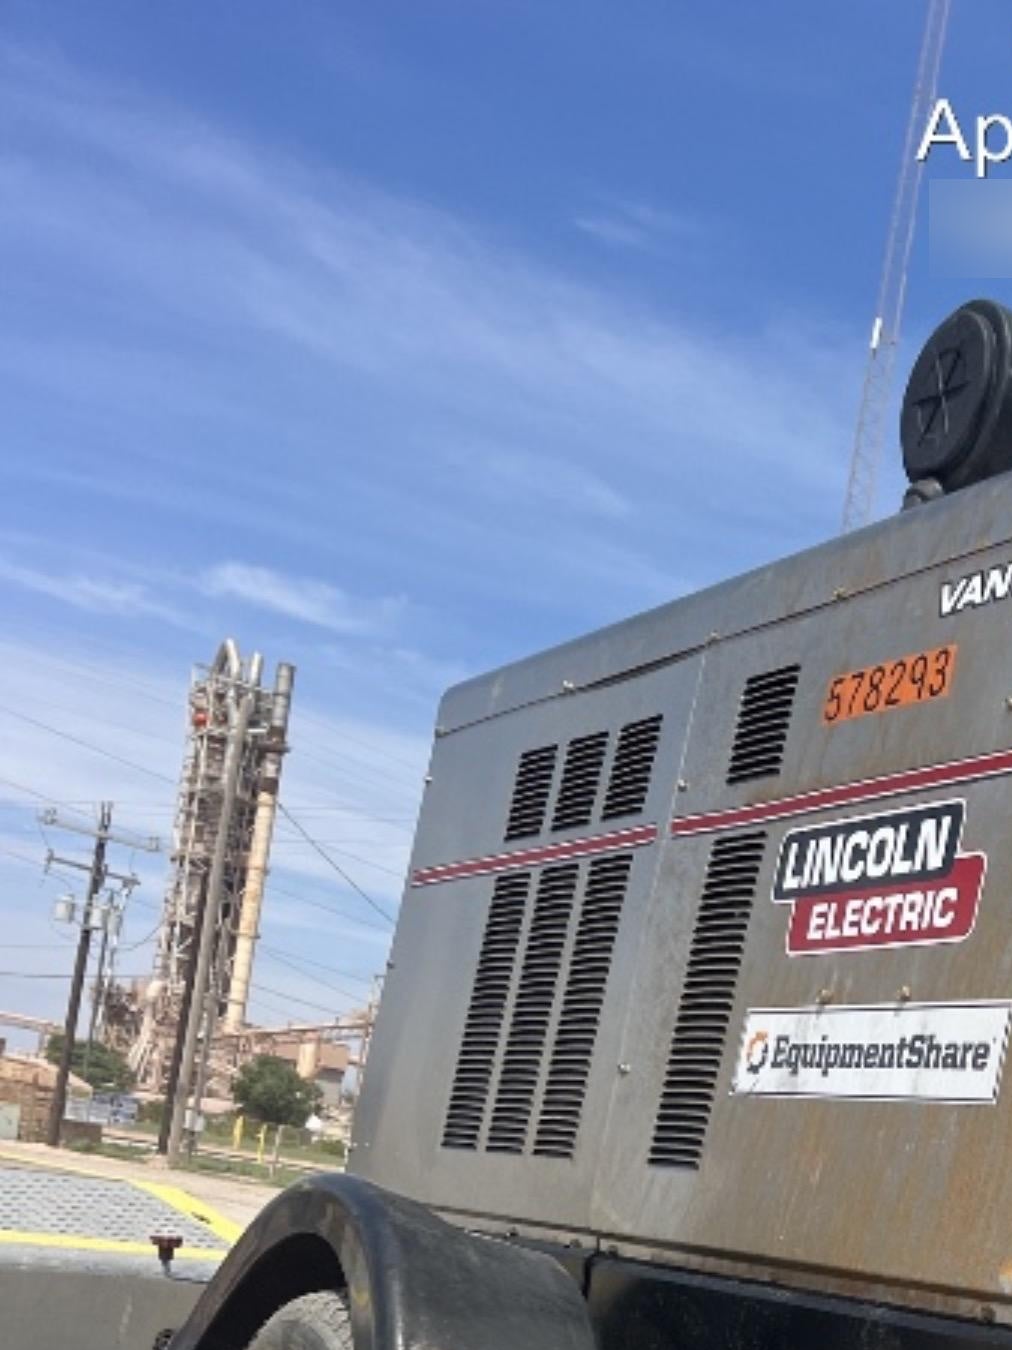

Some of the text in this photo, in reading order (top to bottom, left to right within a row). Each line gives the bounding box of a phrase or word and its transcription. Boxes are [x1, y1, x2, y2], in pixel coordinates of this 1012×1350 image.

[825, 650, 951, 721] 578293
[783, 815, 951, 890] LINCOLN
[806, 886, 957, 940] ELECTRIC
[770, 1033, 992, 1077] EquipmentShare
